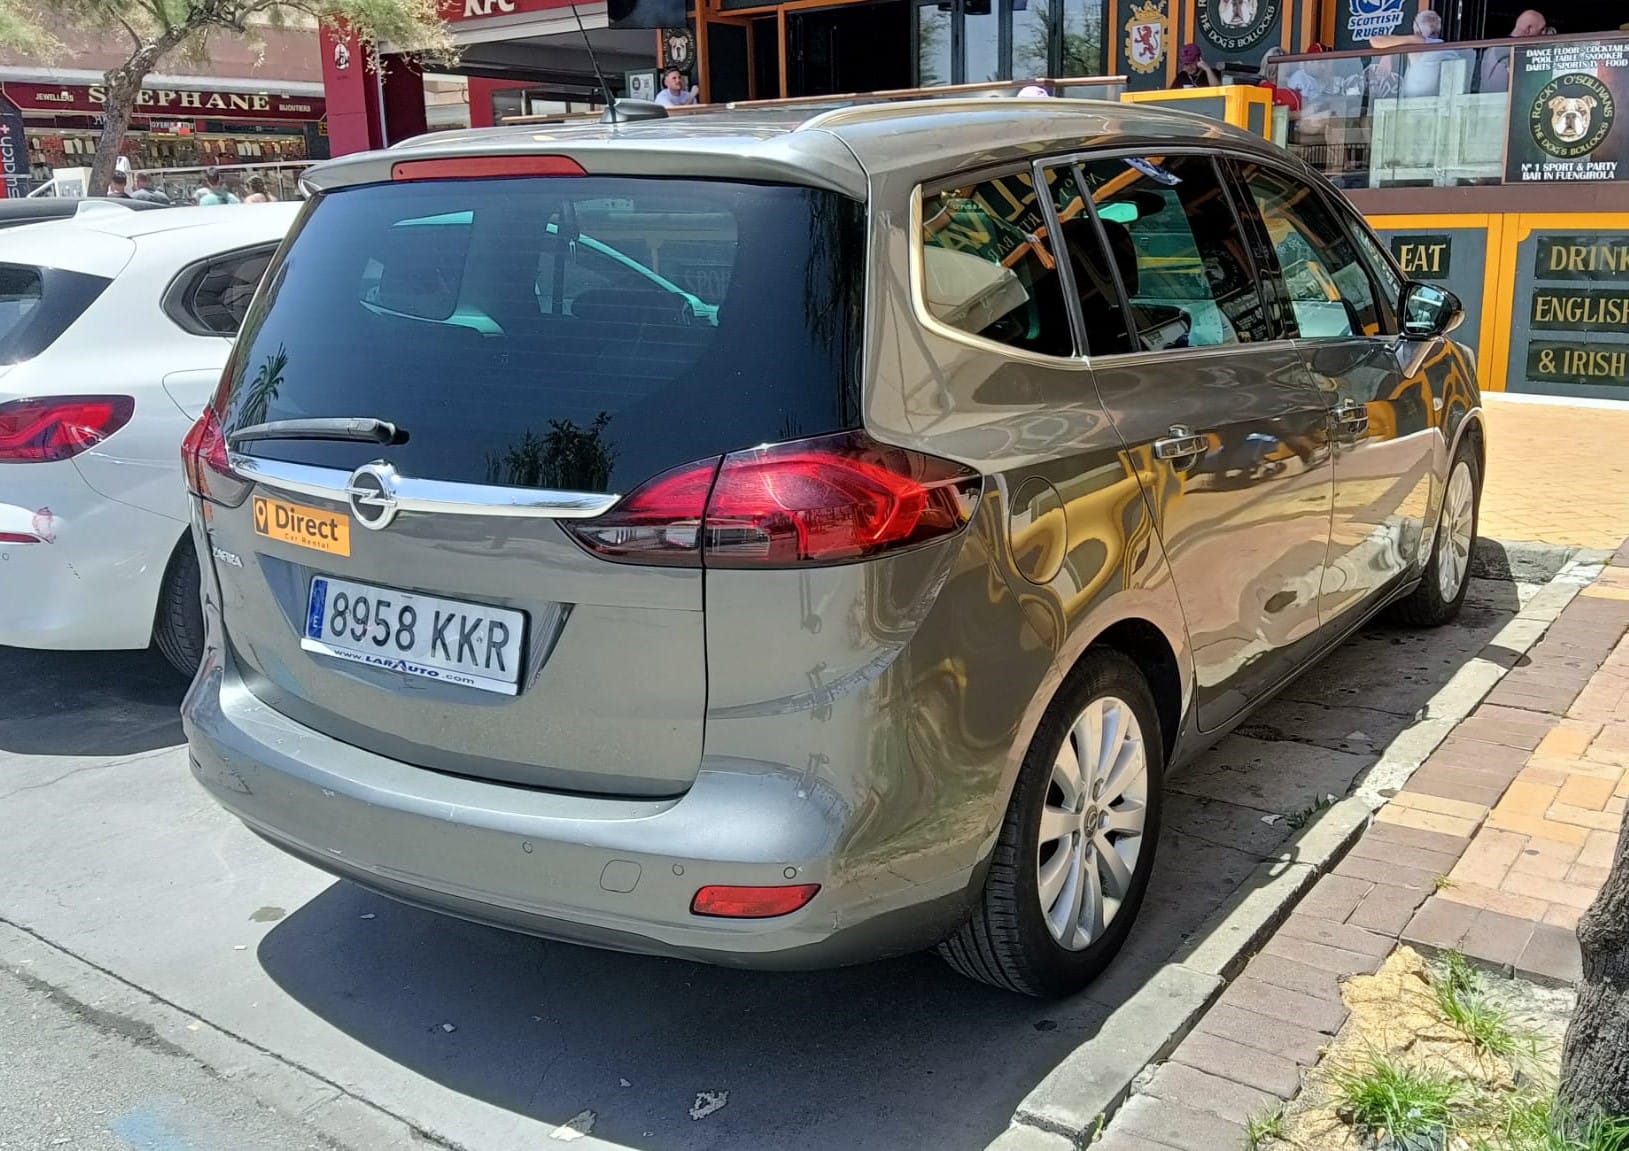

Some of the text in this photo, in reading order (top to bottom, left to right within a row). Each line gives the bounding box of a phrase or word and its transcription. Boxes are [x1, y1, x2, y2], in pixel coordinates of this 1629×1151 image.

[1349, 13, 1401, 28] SCOTTISH
[1208, 30, 1235, 49] DOG'S
[1354, 25, 1393, 39] RUGBY
[1526, 44, 1629, 57] DANCE FLOOR COCKTAILS
[1531, 52, 1623, 64] POOL TABLE SNOOKER
[1526, 63, 1551, 71] DARTS
[1558, 61, 1589, 69] SPORTS
[1590, 60, 1599, 68] TV
[1605, 59, 1628, 68] FOOD
[88, 87, 269, 110] SEPHANE
[1532, 75, 1613, 119] ROCKY O'SULLIVANS
[1533, 121, 1609, 156] THE DOG'S BOLLOCKS
[1522, 171, 1615, 180] BAR IN FUENGIROLA
[1534, 163, 1540, 172] 1
[1542, 162, 1574, 172] SPORT
[1577, 162, 1584, 171] &
[1586, 161, 1617, 171] PARTY
[1400, 244, 1446, 272] EAT
[1538, 349, 1626, 378] & IRISH
[274, 504, 338, 541] Direct
[284, 532, 329, 549] Car Rental
[330, 592, 417, 652] 8958
[430, 610, 510, 673] KKR
